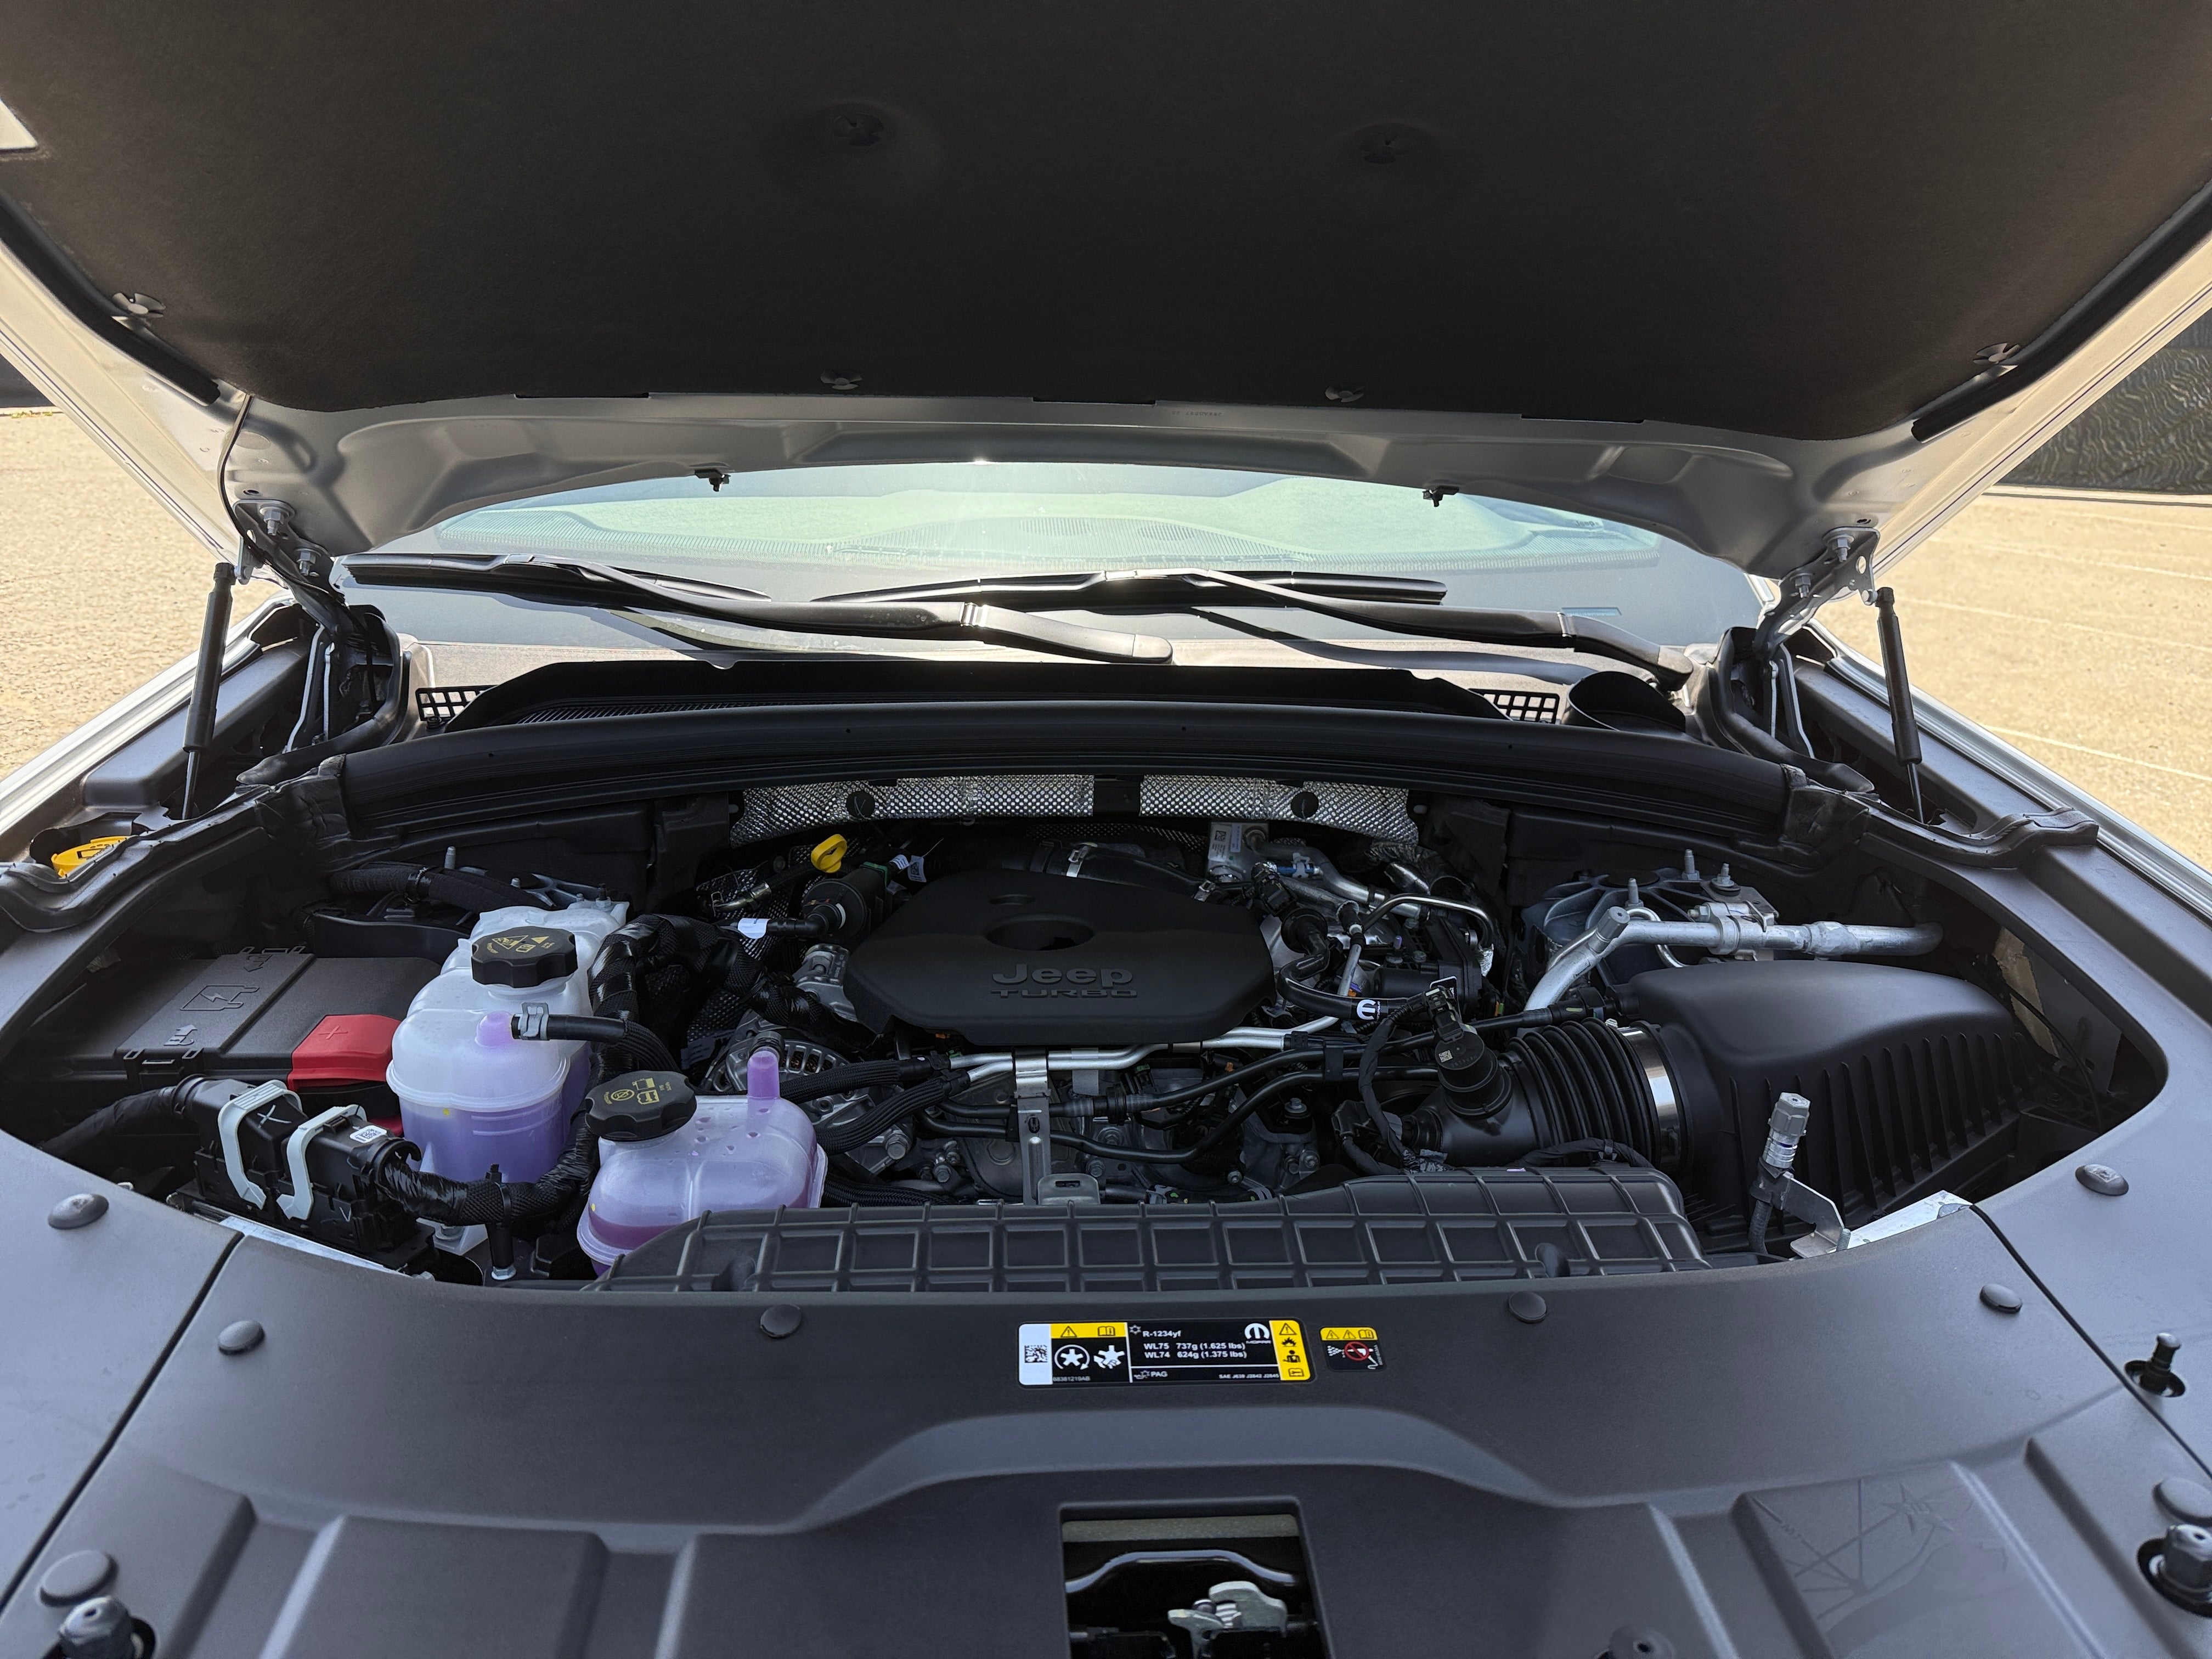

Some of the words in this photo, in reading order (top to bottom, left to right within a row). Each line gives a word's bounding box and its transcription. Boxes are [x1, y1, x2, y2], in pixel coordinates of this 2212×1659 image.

[992, 964, 1133, 989] Jeep
[991, 990, 1137, 998] TURBO
[1143, 1330, 1181, 1339] R-1234yf
[1176, 1342, 1198, 1351] 737g
[1200, 1342, 1227, 1351] (1.625
